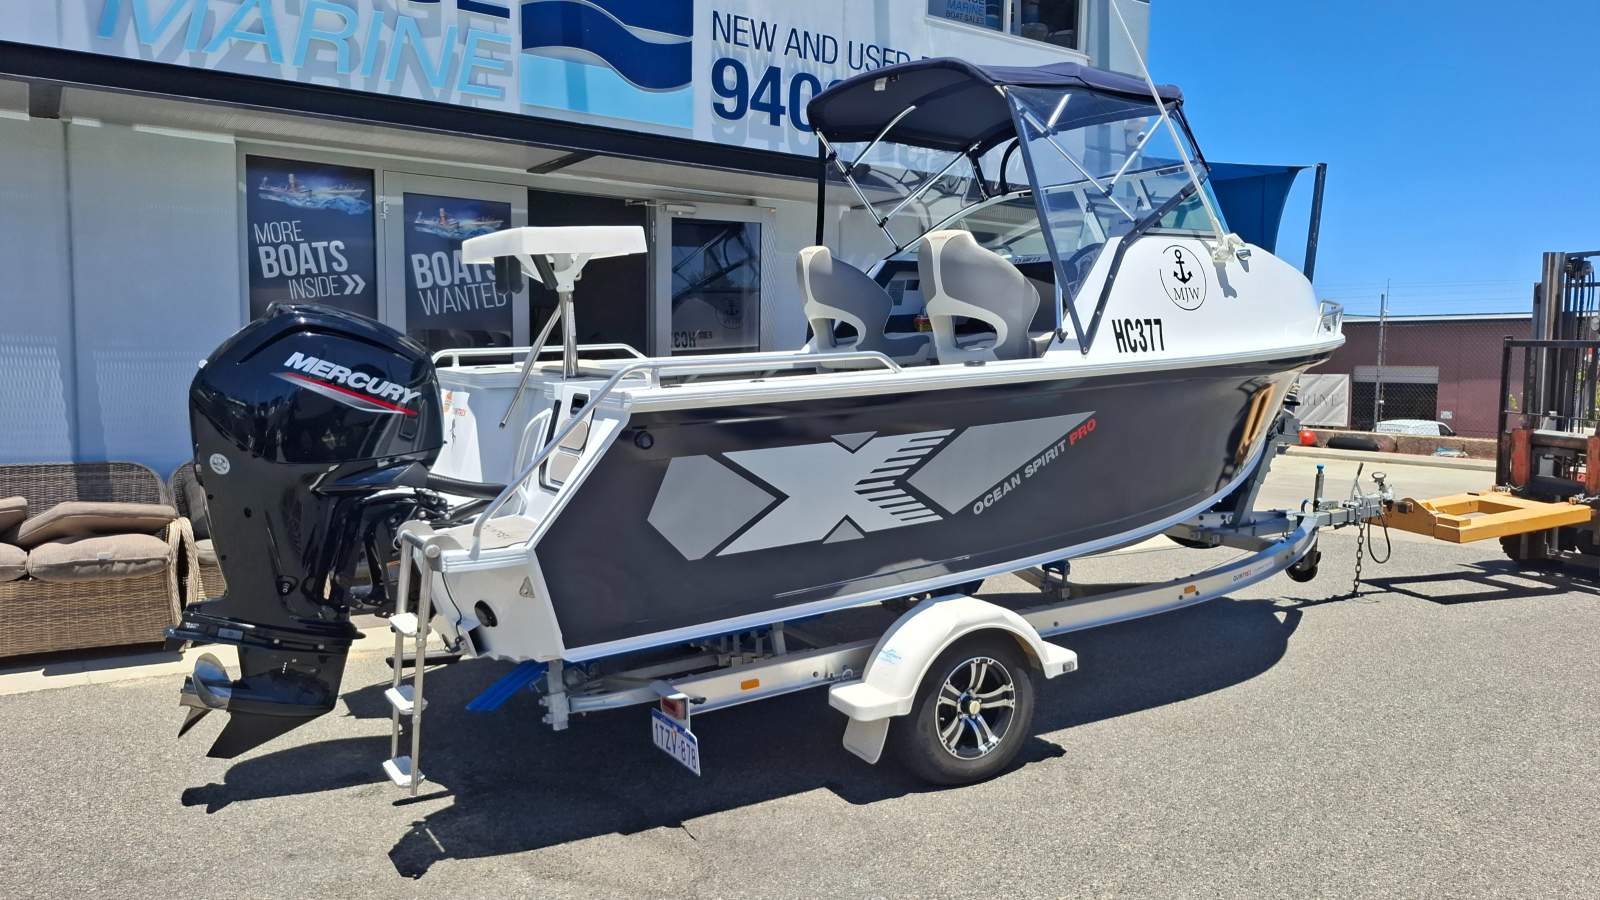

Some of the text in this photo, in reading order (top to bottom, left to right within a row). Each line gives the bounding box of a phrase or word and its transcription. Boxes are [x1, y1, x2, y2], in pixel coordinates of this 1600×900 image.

[946, 1, 985, 18] MARINE
[97, 0, 512, 97] MARINE
[712, 10, 777, 51] NEW
[784, 28, 838, 64] AND
[711, 57, 845, 133] 940
[253, 221, 304, 244] MORE
[258, 240, 349, 279] BOATS
[288, 275, 339, 300] INSIDE
[418, 282, 507, 316] WANTED
[1173, 287, 1200, 303] MJW
[1112, 318, 1165, 353] HC377
[283, 351, 422, 404] MERCURY
[973, 418, 1096, 515] OCEAN SPIRIT PRO
